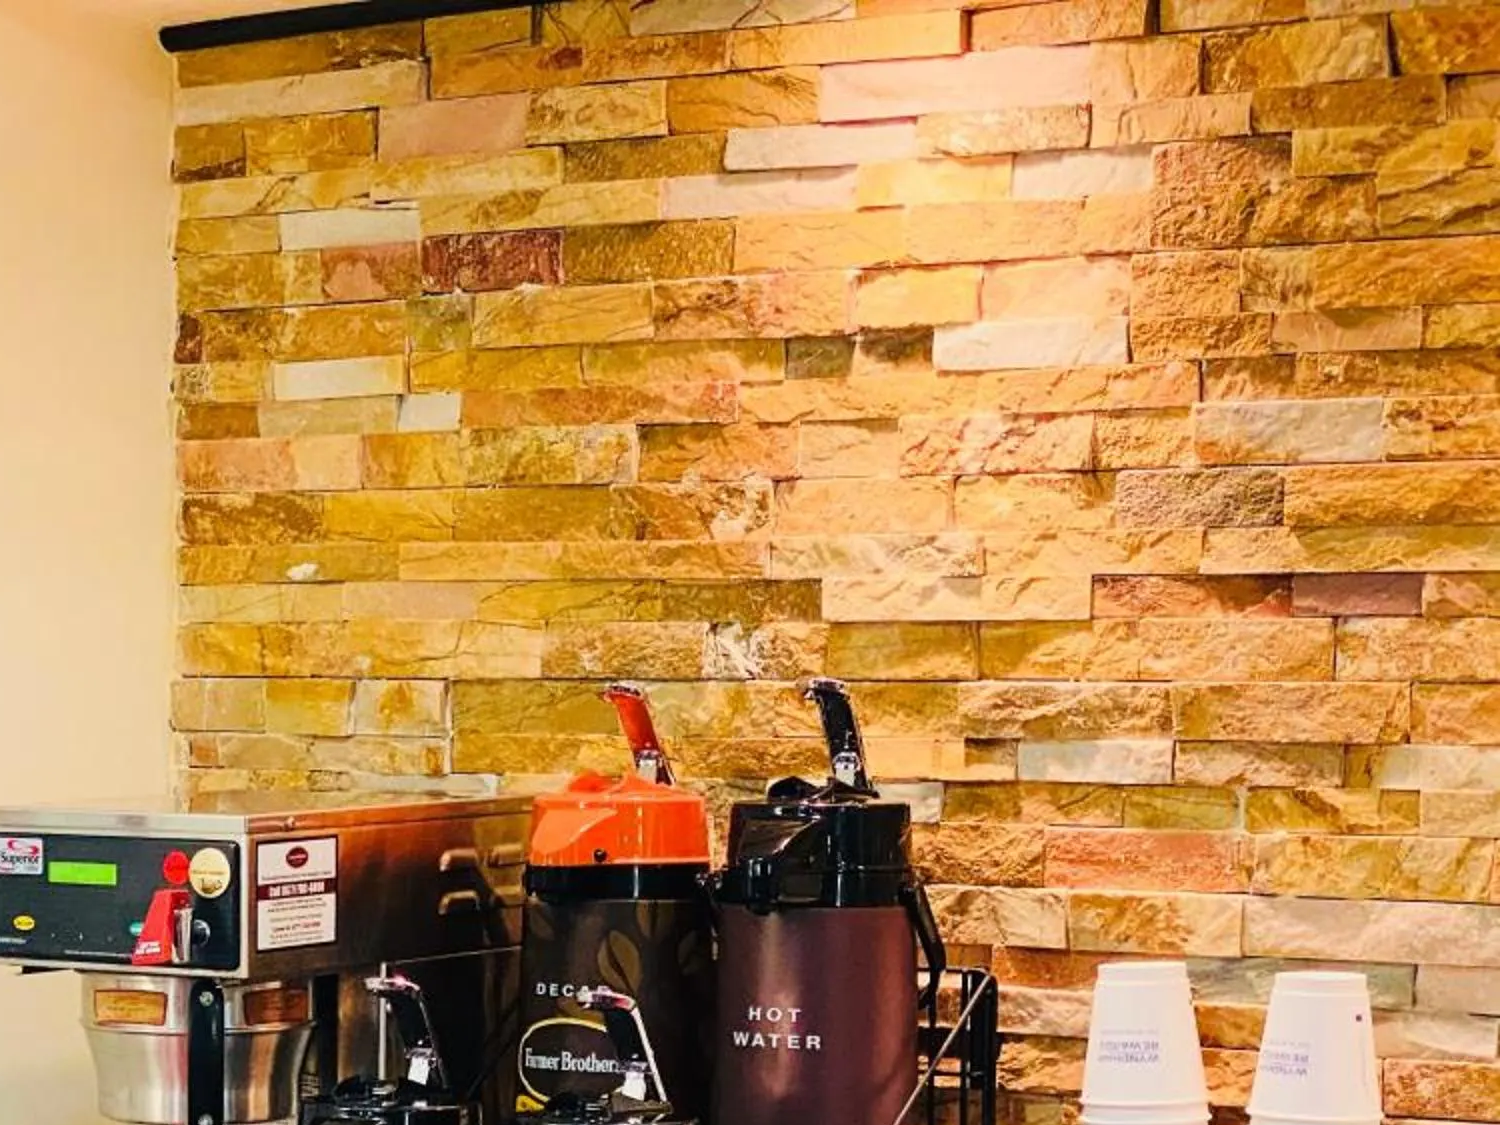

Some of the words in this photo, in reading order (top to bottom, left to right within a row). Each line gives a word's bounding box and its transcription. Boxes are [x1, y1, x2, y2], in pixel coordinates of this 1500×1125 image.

[748, 1006, 803, 1023] HOT
[733, 1031, 821, 1050] WATER
[561, 1051, 622, 1073] Brother
